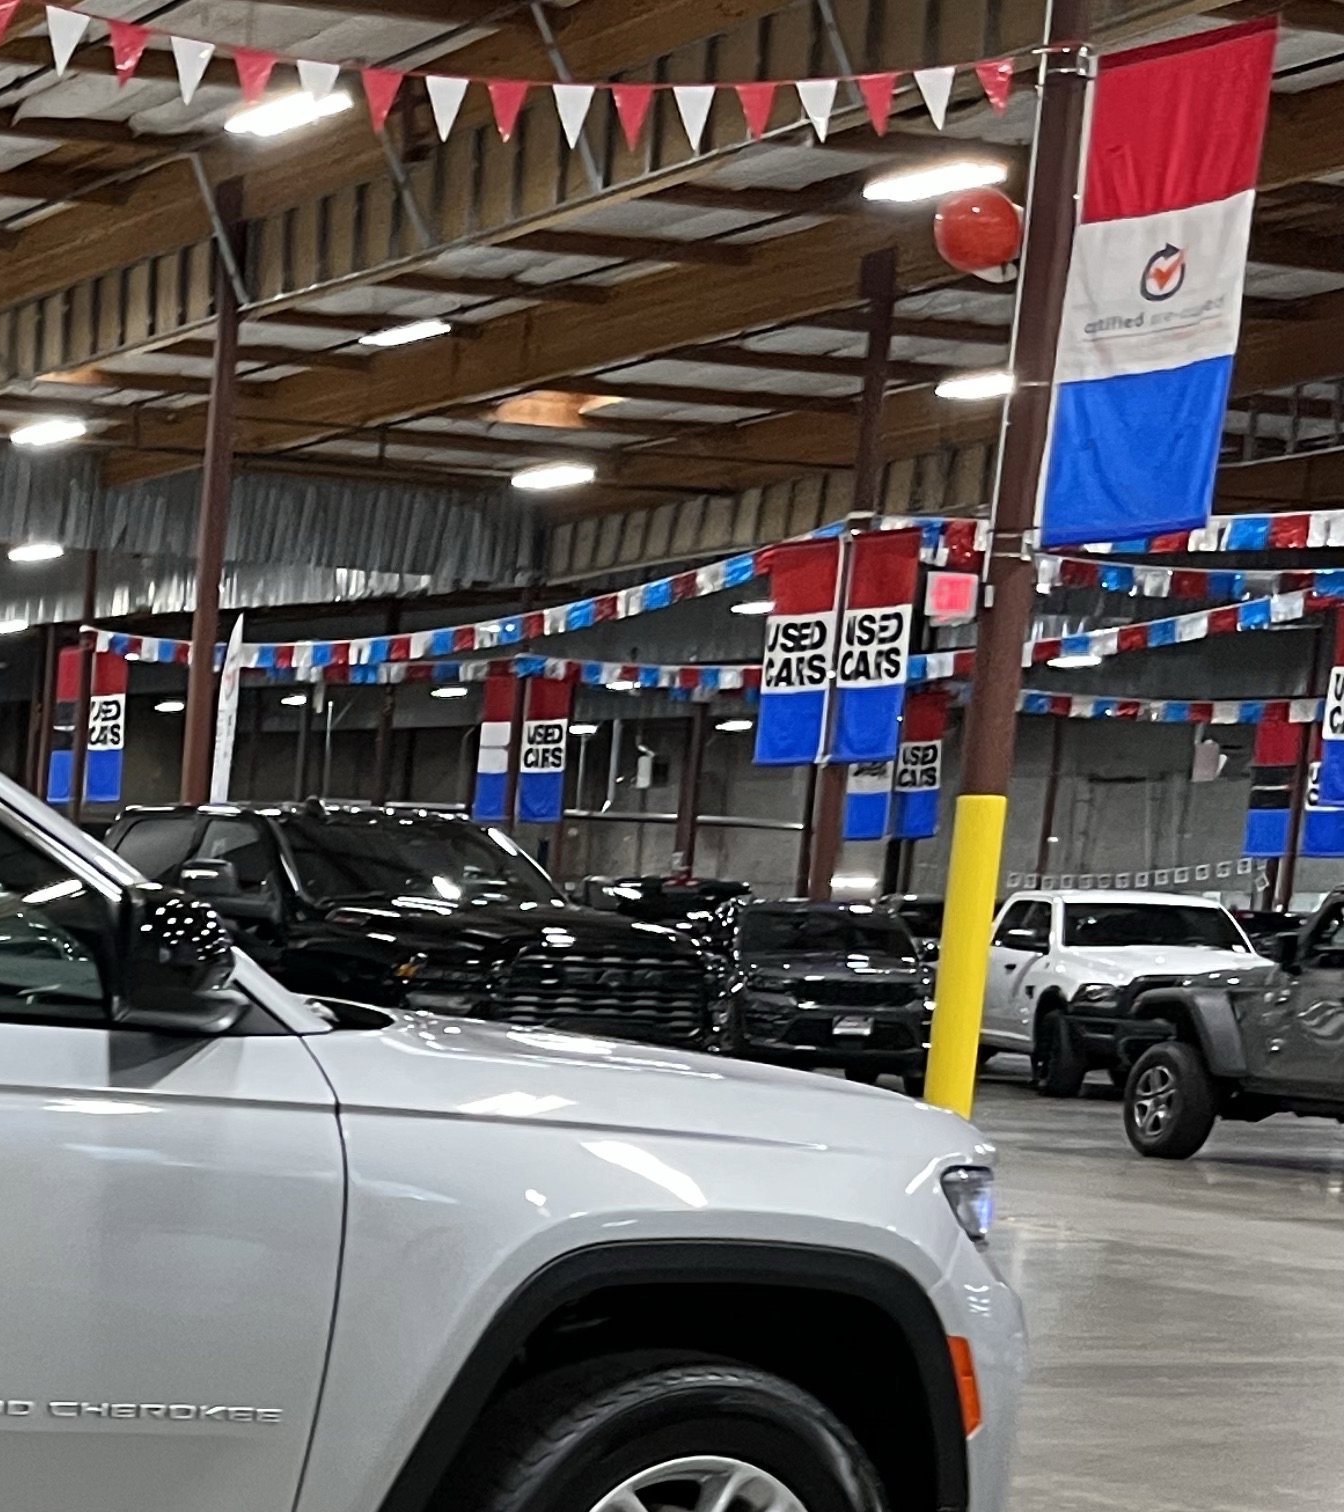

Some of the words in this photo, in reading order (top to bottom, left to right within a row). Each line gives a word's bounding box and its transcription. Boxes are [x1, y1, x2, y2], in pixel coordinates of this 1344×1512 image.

[765, 654, 827, 687] CARS
[841, 647, 901, 681] CARS
[527, 724, 563, 745] USED
[48, 1401, 284, 1424] CHEROKEE
